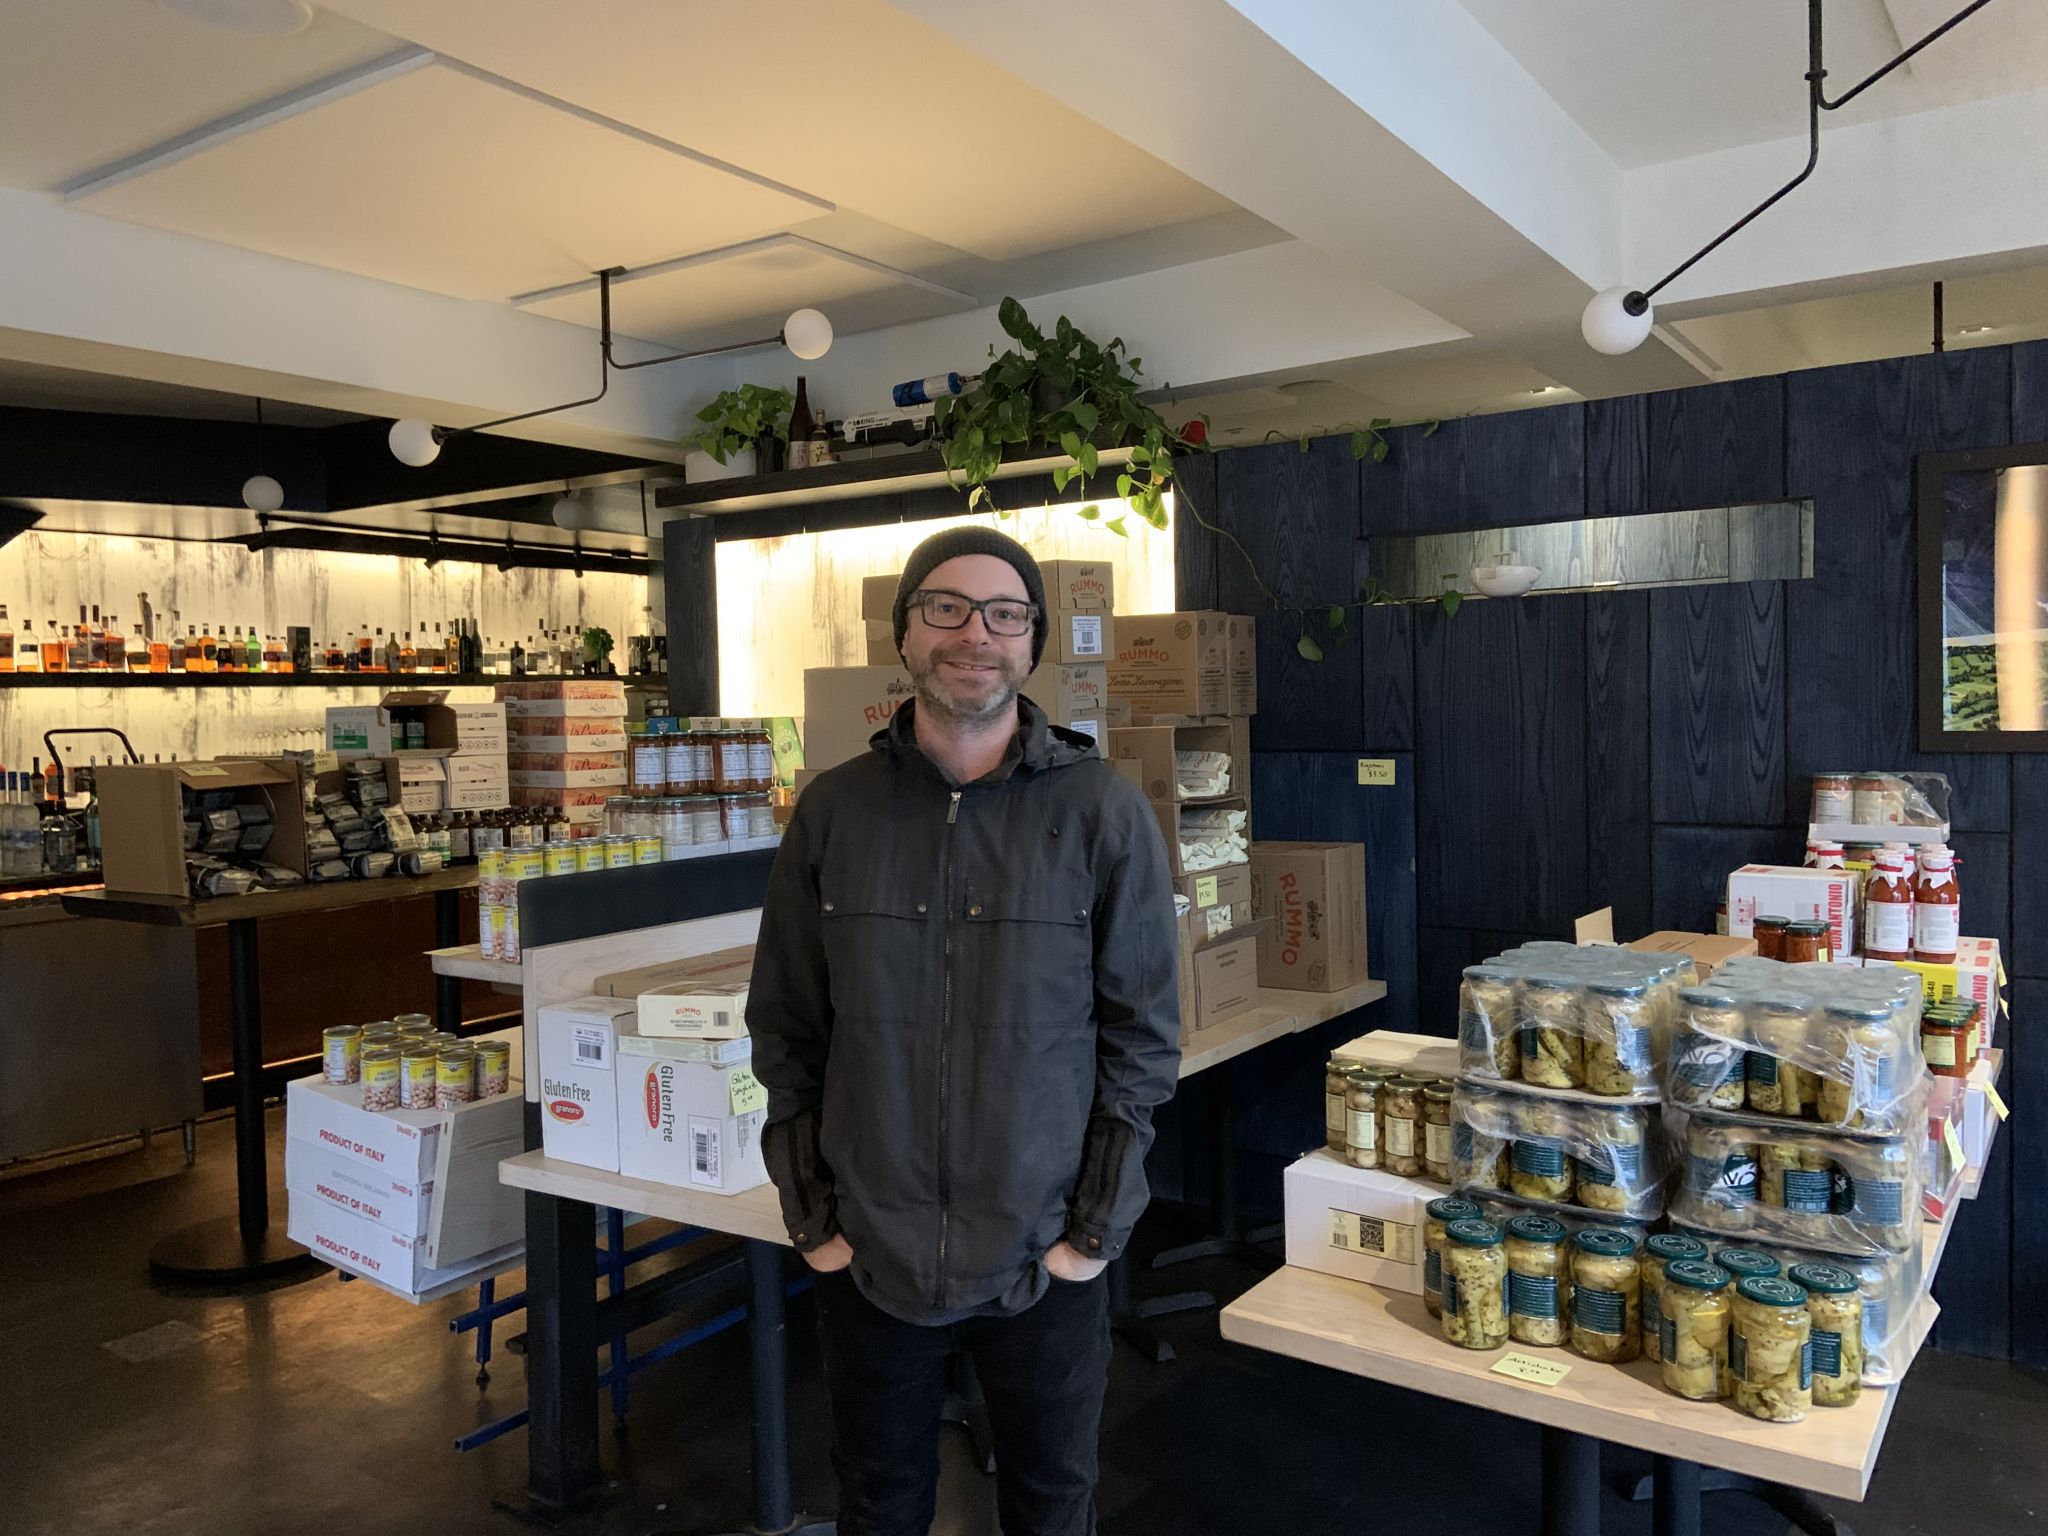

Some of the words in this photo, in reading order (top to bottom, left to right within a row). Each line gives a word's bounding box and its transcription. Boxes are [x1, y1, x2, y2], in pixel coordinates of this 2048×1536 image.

[1070, 579, 1105, 595] RUMMO
[1119, 649, 1169, 664] RUMMO
[1280, 872, 1303, 966] RUMMO
[1827, 884, 1843, 928] ANTONIO
[675, 1007, 702, 1016] RUMMO
[544, 1078, 571, 1099] Gluten
[572, 1083, 591, 1102] Free
[649, 1081, 657, 1122] granoro
[661, 1065, 674, 1111] Gluten
[662, 1113, 675, 1143] Free
[319, 1129, 352, 1150] PRODUCT
[353, 1142, 364, 1155] OF
[365, 1147, 386, 1163] ITALY
[316, 1183, 349, 1206] PRODUCT
[350, 1198, 361, 1210] OF
[362, 1203, 382, 1220] ITALY
[316, 1234, 348, 1257] PRODUCT
[350, 1249, 361, 1262] OF
[361, 1255, 381, 1271] ITALY
